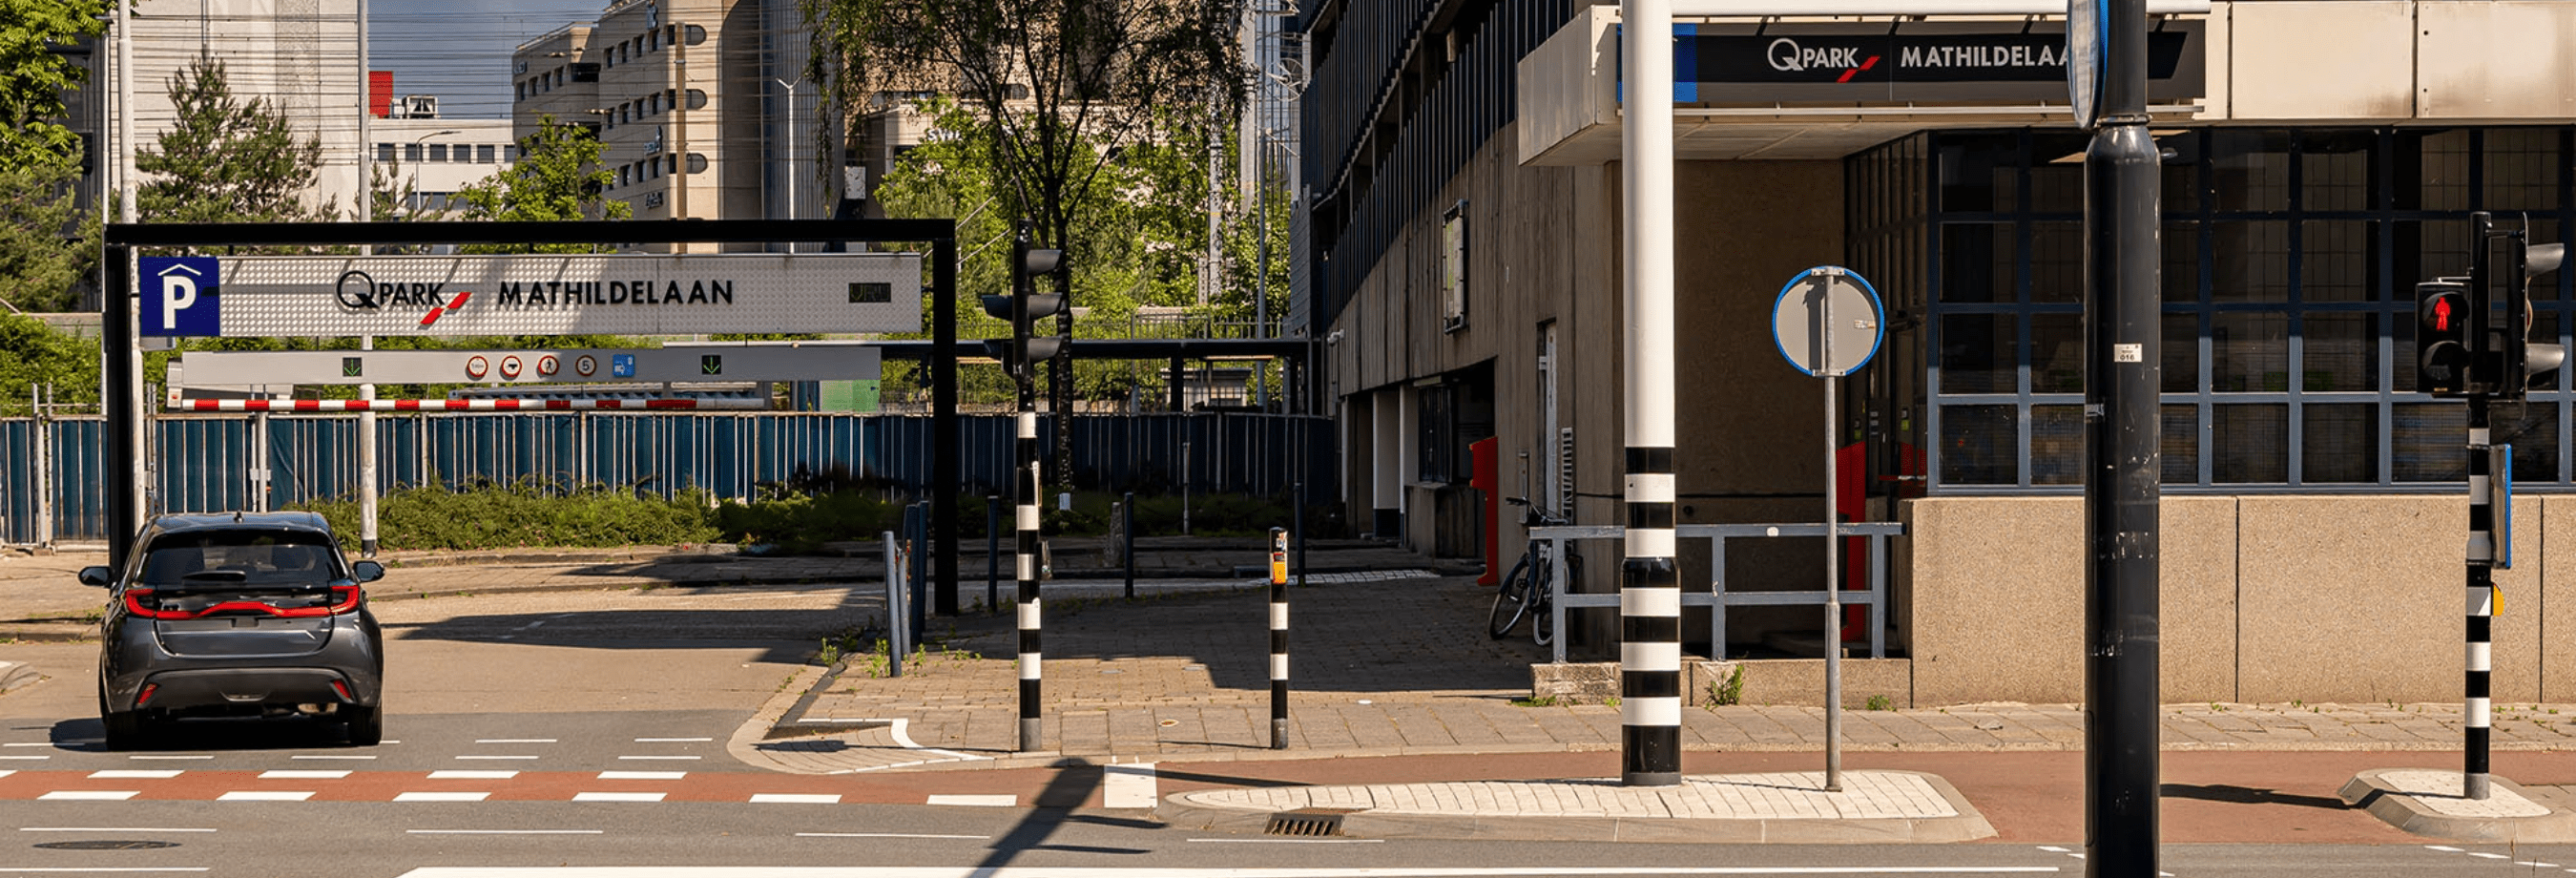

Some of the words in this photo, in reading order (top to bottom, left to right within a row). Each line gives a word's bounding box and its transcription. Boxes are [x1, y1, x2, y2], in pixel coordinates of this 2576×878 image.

[163, 275, 197, 329] P
[498, 280, 733, 305] MATHILDELAAN
[582, 359, 590, 372] 5
